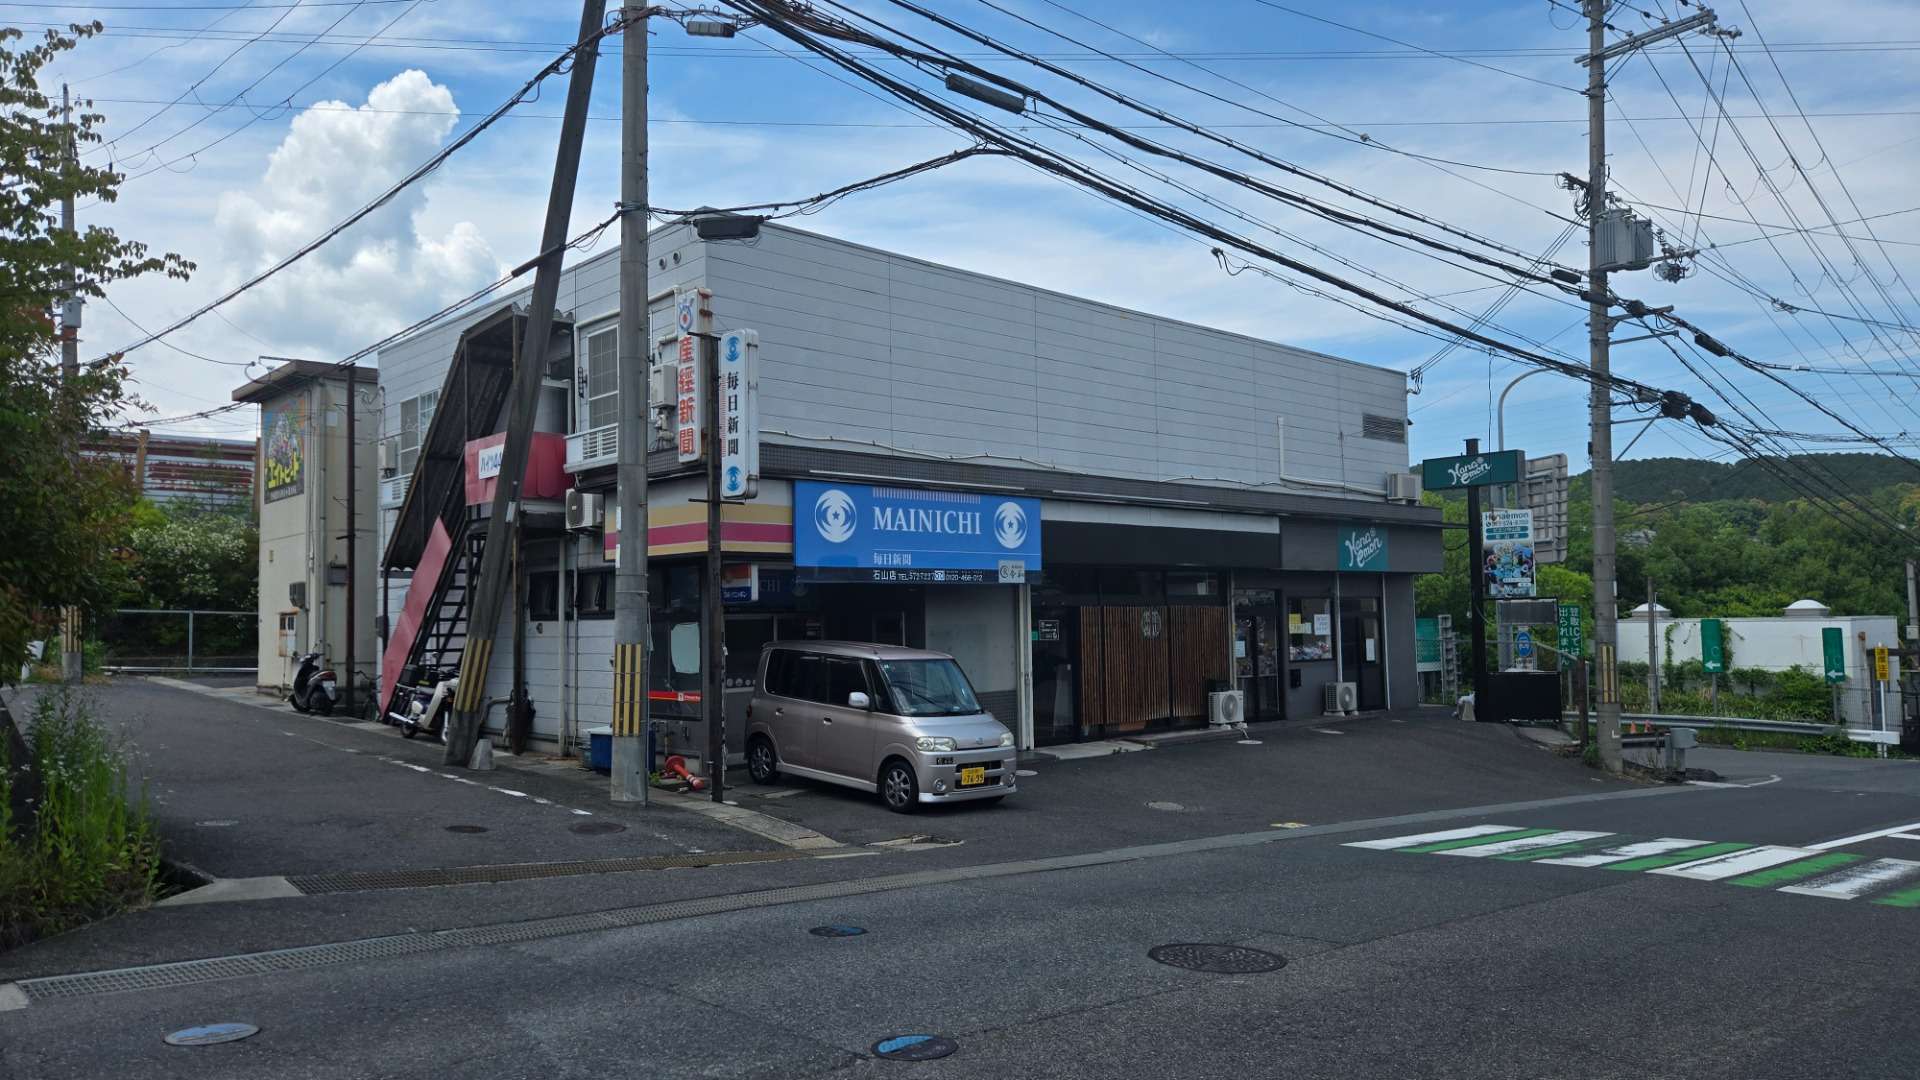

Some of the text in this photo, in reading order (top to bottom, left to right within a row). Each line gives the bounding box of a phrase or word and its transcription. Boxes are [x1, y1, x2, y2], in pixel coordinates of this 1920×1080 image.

[727, 371, 739, 456] 毎日新聞
[872, 506, 983, 535] MAINICHI
[873, 552, 912, 566] 毎日新聞
[872, 569, 897, 580] 石山店
